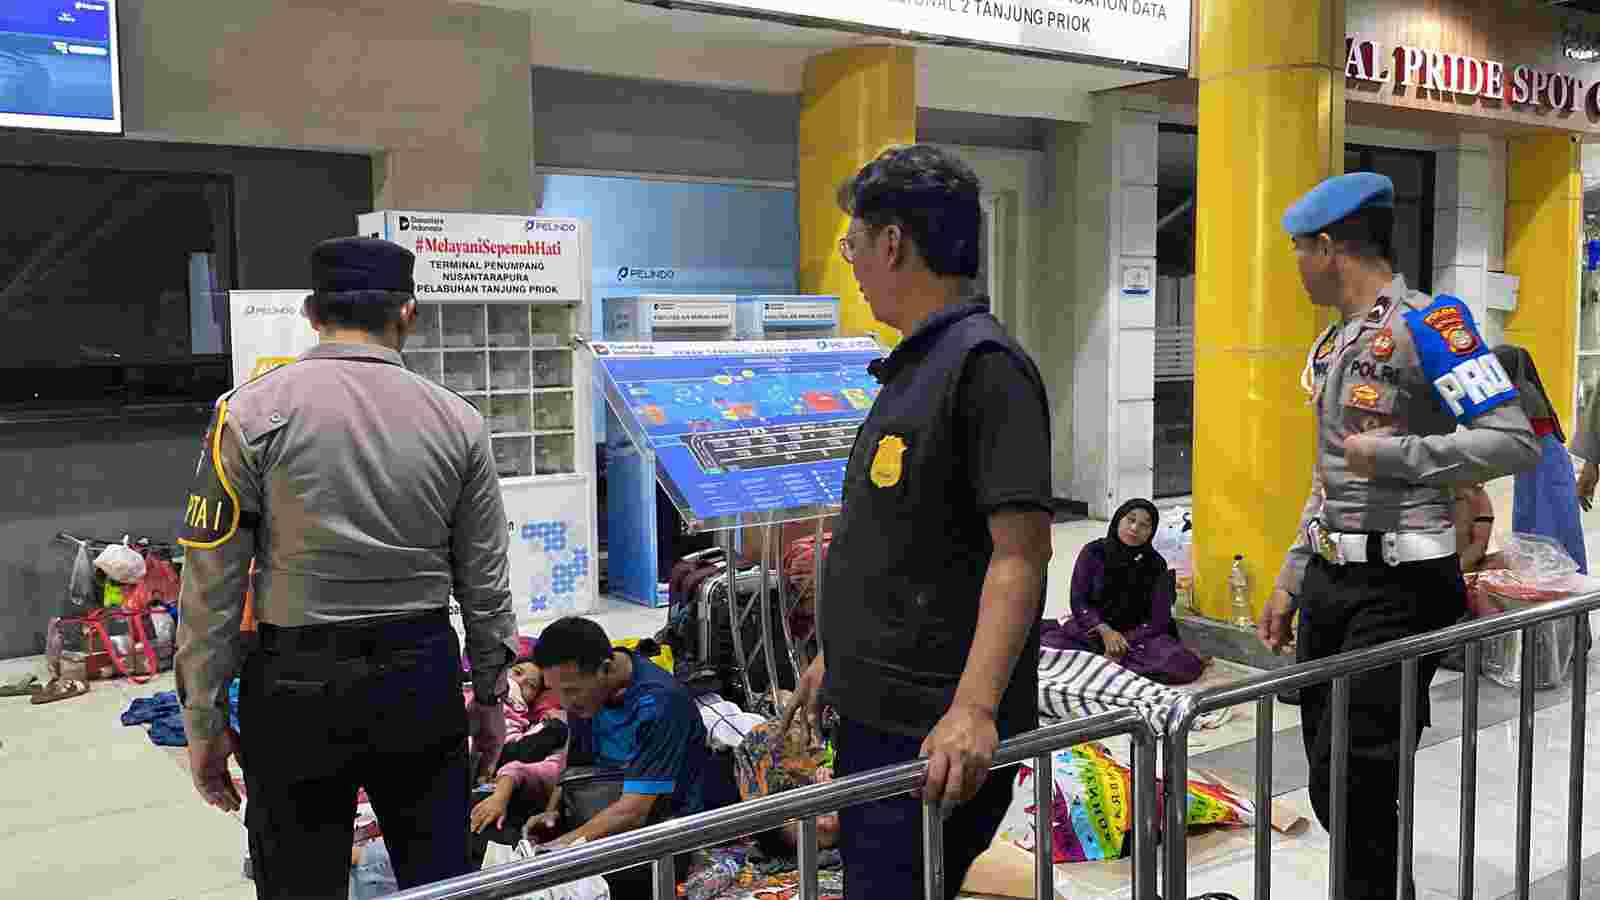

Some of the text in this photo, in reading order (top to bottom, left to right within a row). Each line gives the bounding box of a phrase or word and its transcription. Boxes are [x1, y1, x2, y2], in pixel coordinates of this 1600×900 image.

[961, 0, 969, 13] 2
[976, 0, 1043, 25] TANJUNG
[1047, 11, 1090, 32] PRIOK
[1132, 2, 1166, 21] DATA
[1400, 47, 1504, 98] PRIDE
[1512, 64, 1583, 111] SPOT
[416, 238, 561, 257] #MelayaniSepenuhHati
[430, 261, 545, 271] TERMINAL PENUMPANG
[442, 273, 529, 281] NUSANTARAPURA
[417, 285, 559, 294] PELABUHAN TANJUNG PRIOK
